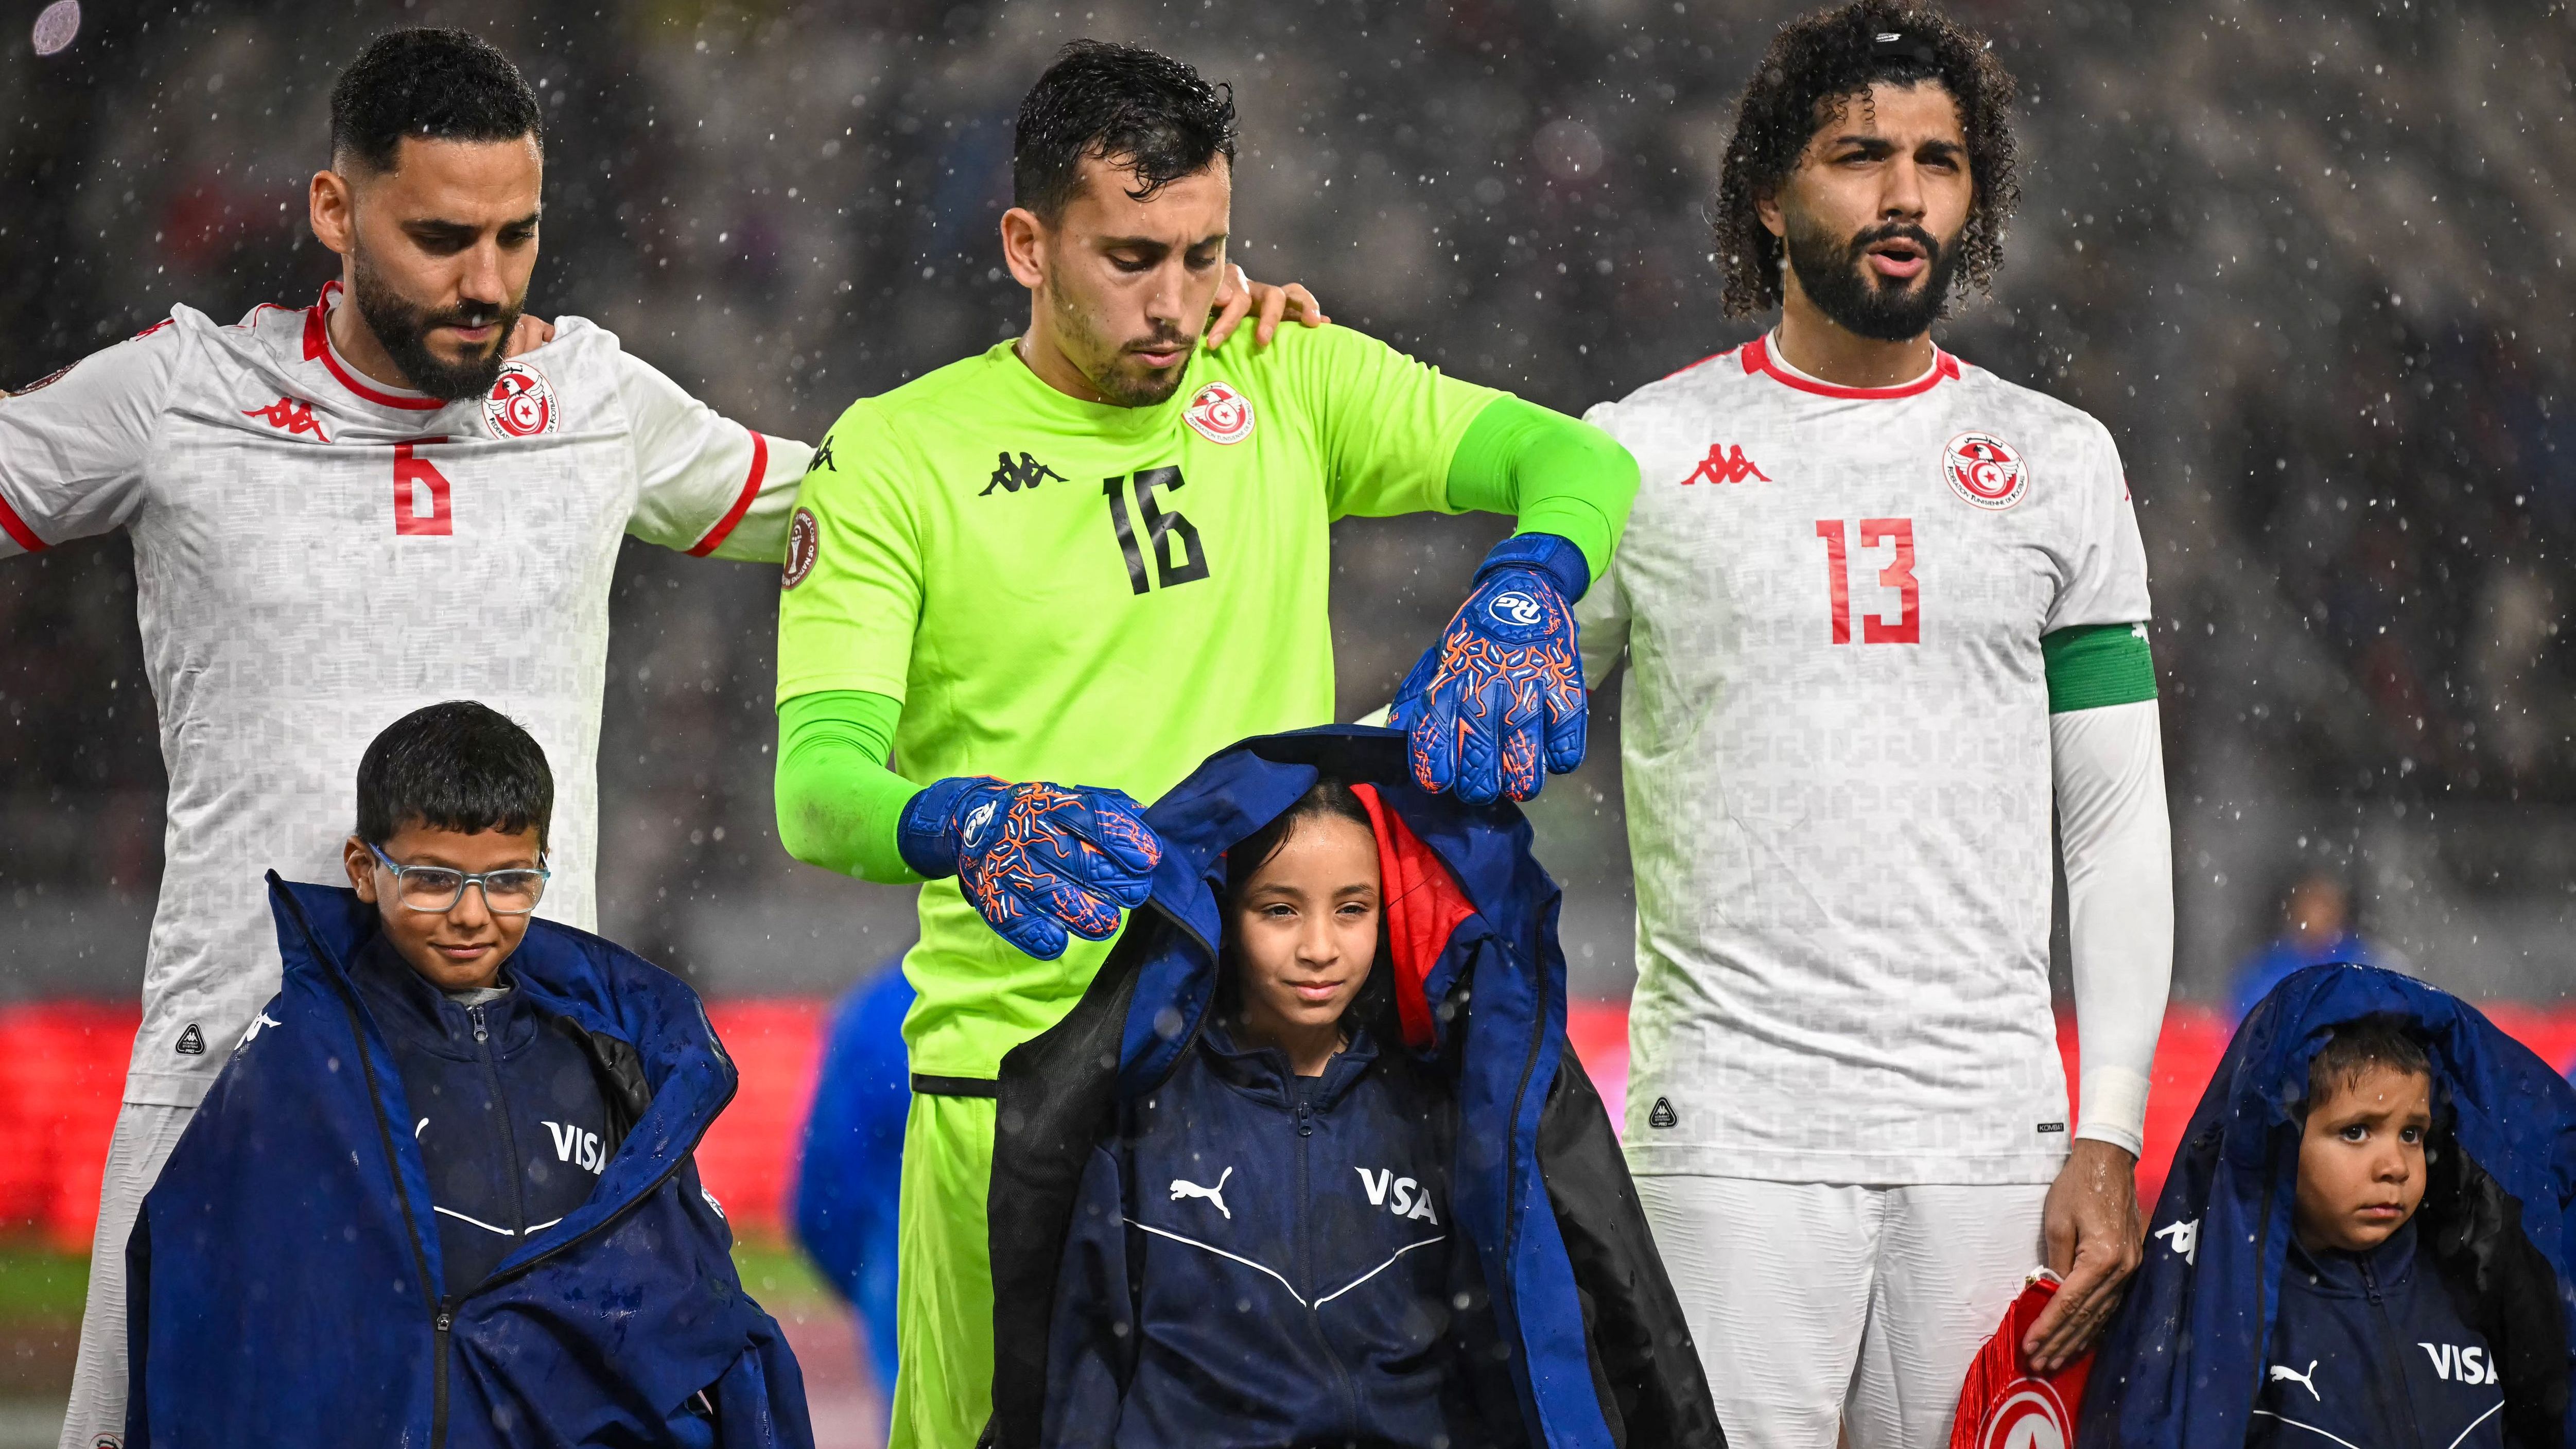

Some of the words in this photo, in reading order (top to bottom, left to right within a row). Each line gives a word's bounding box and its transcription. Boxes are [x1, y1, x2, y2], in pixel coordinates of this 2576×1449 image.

[548, 394, 556, 424] FOOTBALL
[490, 417, 510, 439] FEDERAT
[548, 424, 554, 433] DE
[393, 435, 453, 535] 6
[1103, 465, 1210, 596] 16
[808, 545, 814, 557] OF
[791, 557, 812, 585] NATIONS
[1816, 518, 1920, 644] 13
